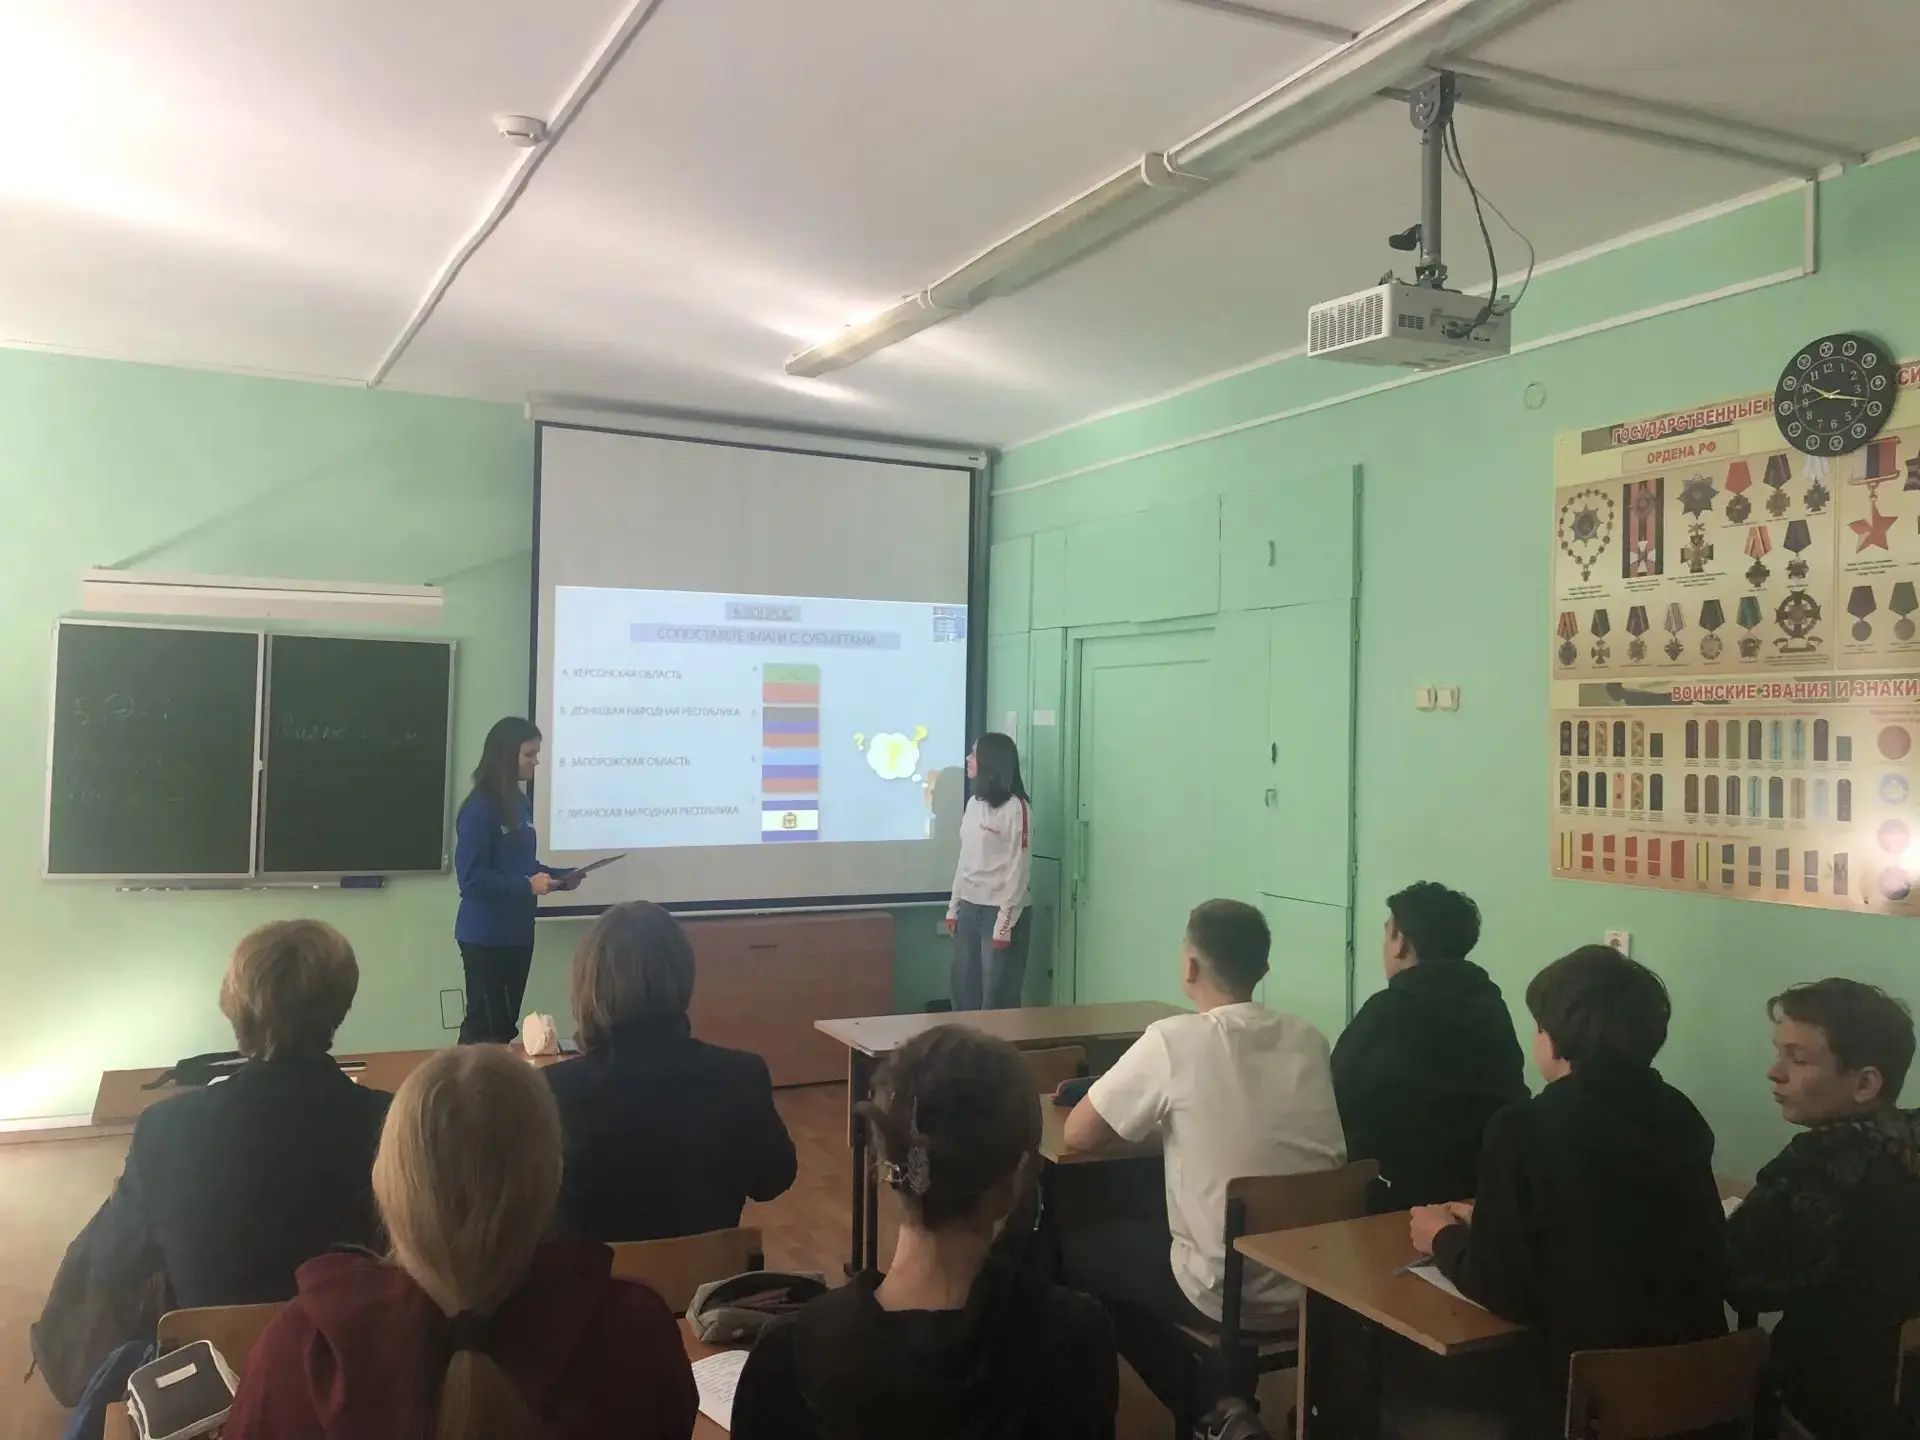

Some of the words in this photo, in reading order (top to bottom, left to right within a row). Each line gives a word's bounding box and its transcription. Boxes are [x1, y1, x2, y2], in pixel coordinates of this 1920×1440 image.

[1822, 362, 1835, 375] 12
[1810, 371, 1820, 381] 11
[1849, 370, 1858, 381] 2
[1853, 383, 1861, 394] 3
[1611, 398, 1763, 444] ГОСУДАРСТВЕННЫЕ
[1806, 411, 1813, 421] 8
[1844, 411, 1853, 422] 5
[1816, 418, 1824, 429] 7
[1830, 419, 1838, 430] 6
[1647, 445, 1695, 465] ОРДЕНА
[1698, 440, 1717, 455] РФ
[656, 626, 745, 643] СОПОСТАВЬТЕ
[747, 630, 787, 645] ФЛАГИ
[790, 632, 800, 645] С
[573, 668, 636, 678] ХЕРСОНСКАЯ
[638, 669, 682, 679] ОБЛАСТЬ
[1671, 684, 1756, 702] ВОИНСКИЕ
[1761, 682, 1830, 699] ЗВАНИЯ
[1836, 682, 1849, 698] И
[1852, 679, 1920, 697] ЗНАКИ
[570, 706, 625, 717] ДОНЕЦКАЯ
[627, 706, 680, 717] НАРОДНАЯ
[681, 707, 741, 716] РЕСПУБЛИКА
[570, 757, 645, 767] ЗАПОРОЖСКАЯ
[647, 756, 691, 767] ОБЛАСТЬ
[624, 807, 678, 818] НАРОДНАЯ
[679, 806, 740, 816] РЕСПУБЛИКА
